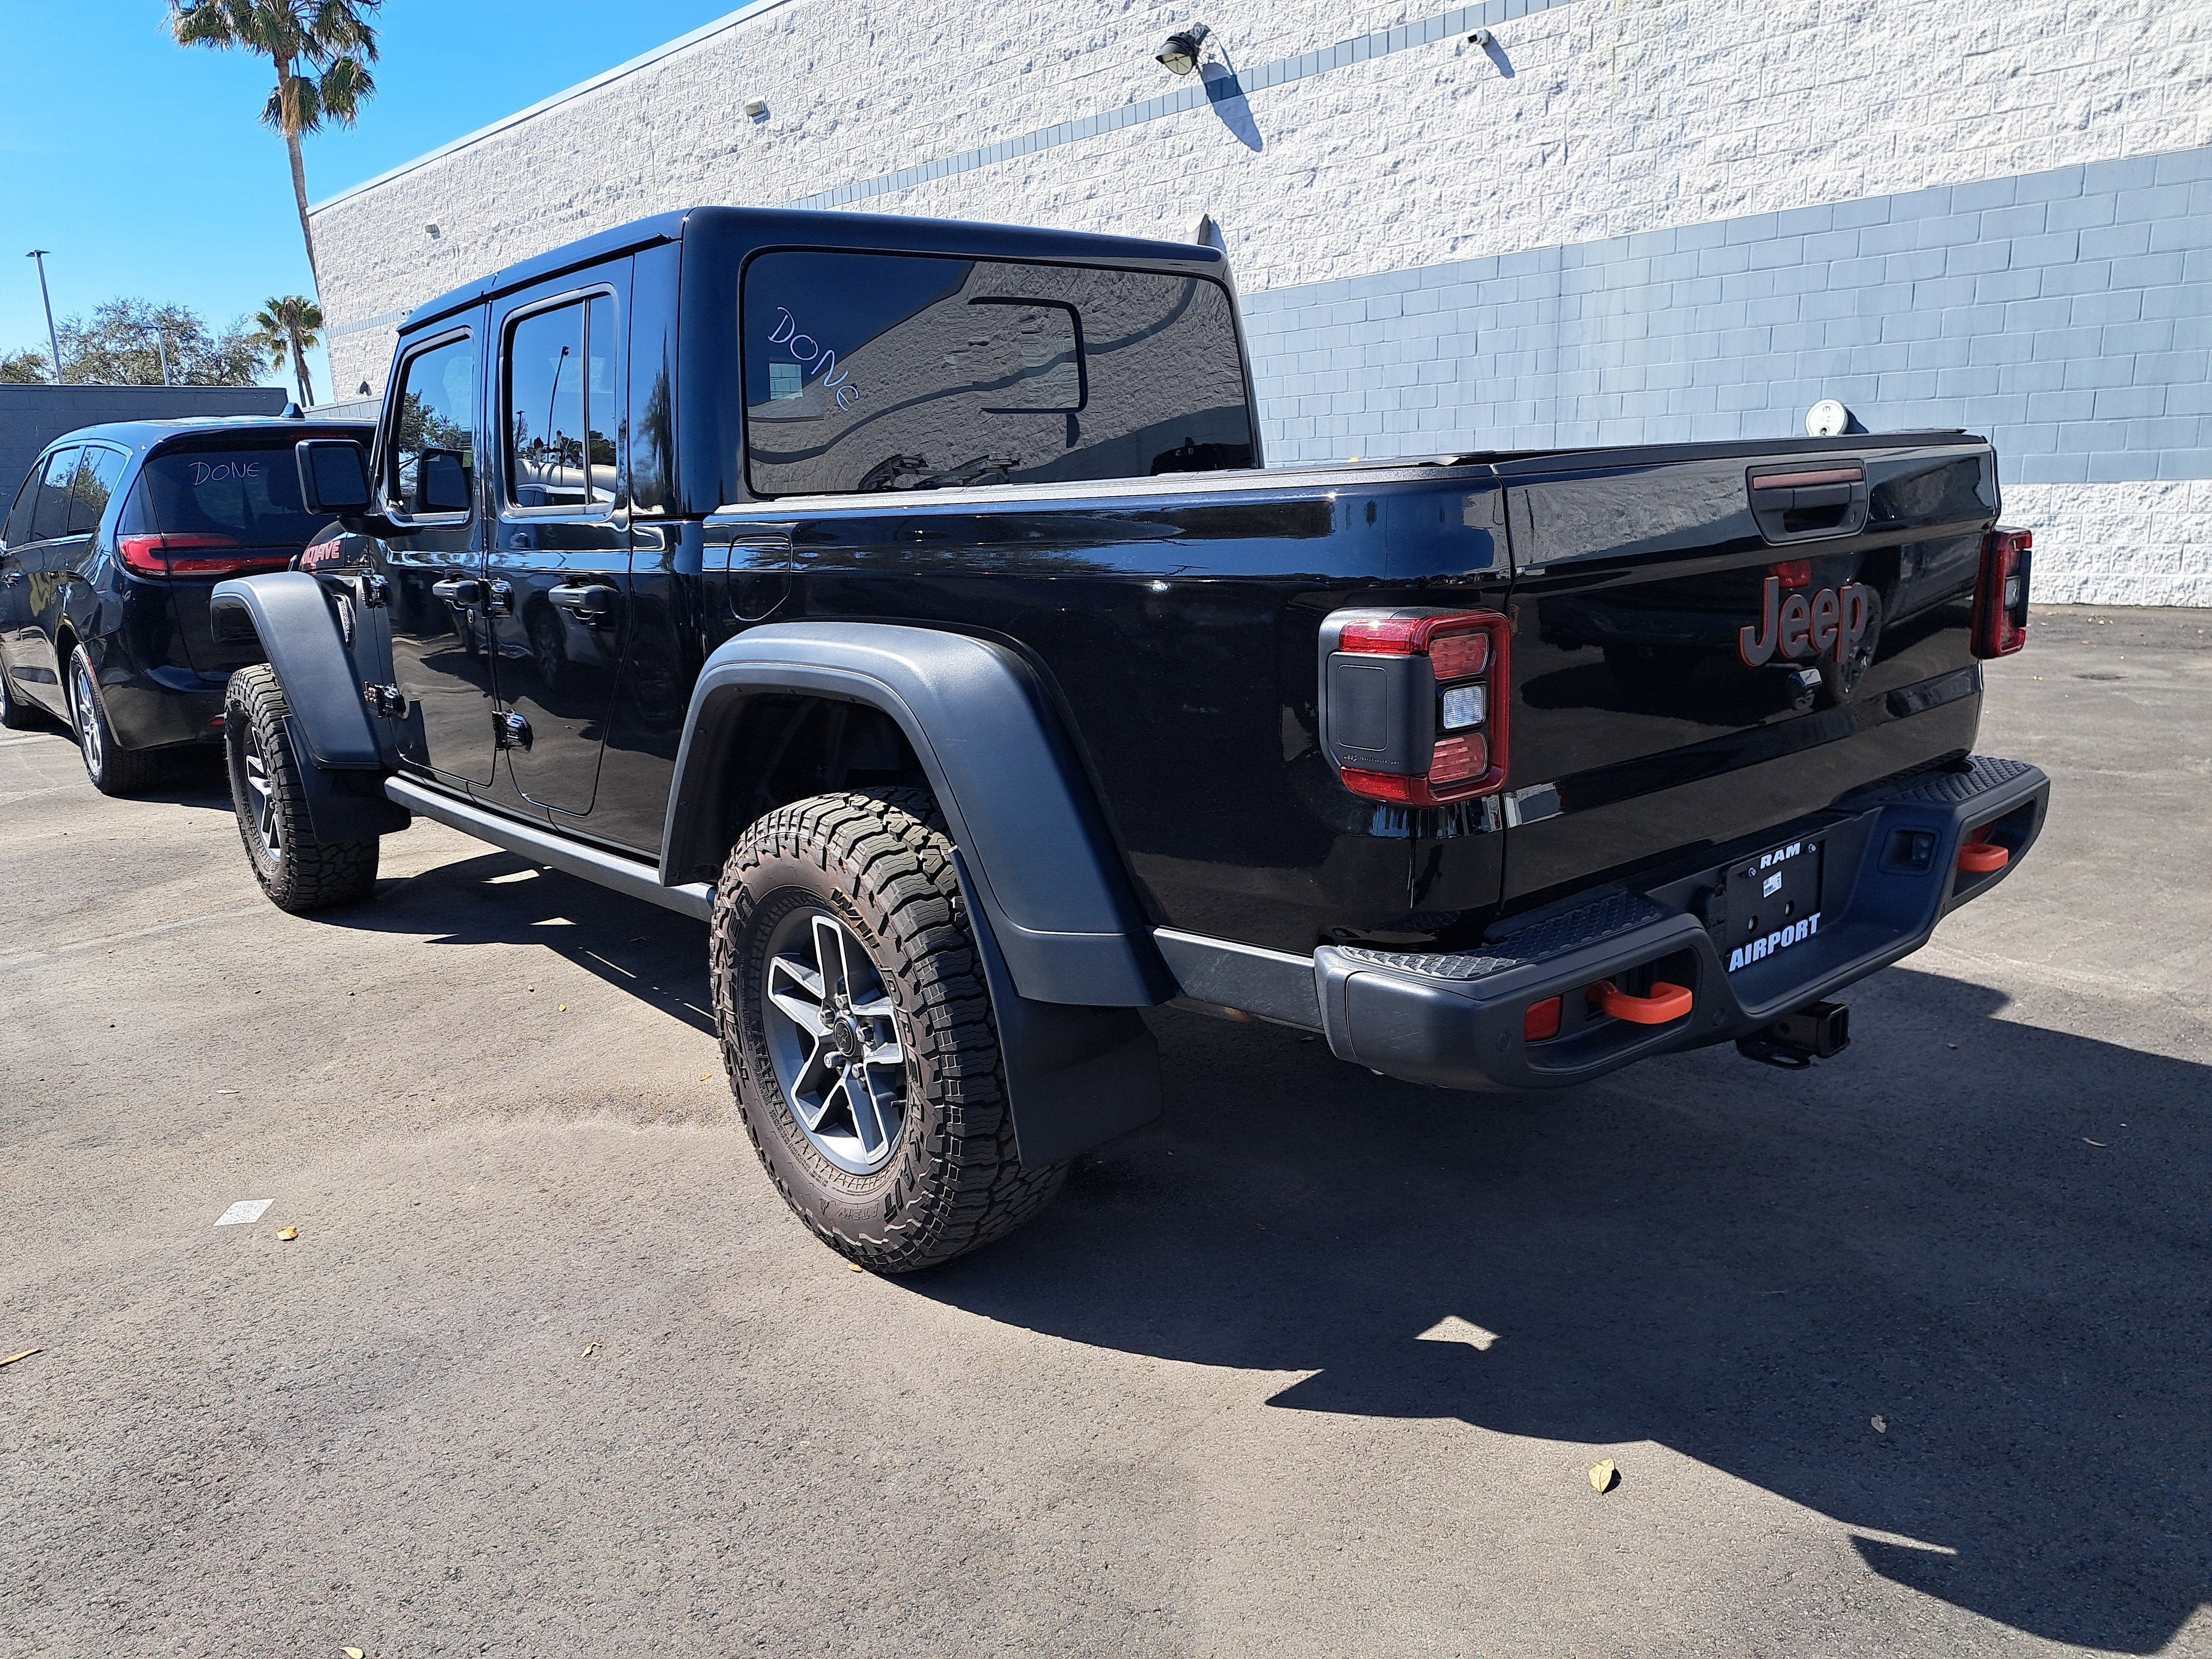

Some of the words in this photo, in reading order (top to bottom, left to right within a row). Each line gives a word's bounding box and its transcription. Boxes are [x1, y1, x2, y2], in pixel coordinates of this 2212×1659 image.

[767, 306, 859, 411] DONE
[189, 460, 260, 486] DONE
[1739, 575, 1869, 667] Jeep
[1760, 841, 1801, 870] RAM
[1728, 912, 1821, 973] AIRPORT
